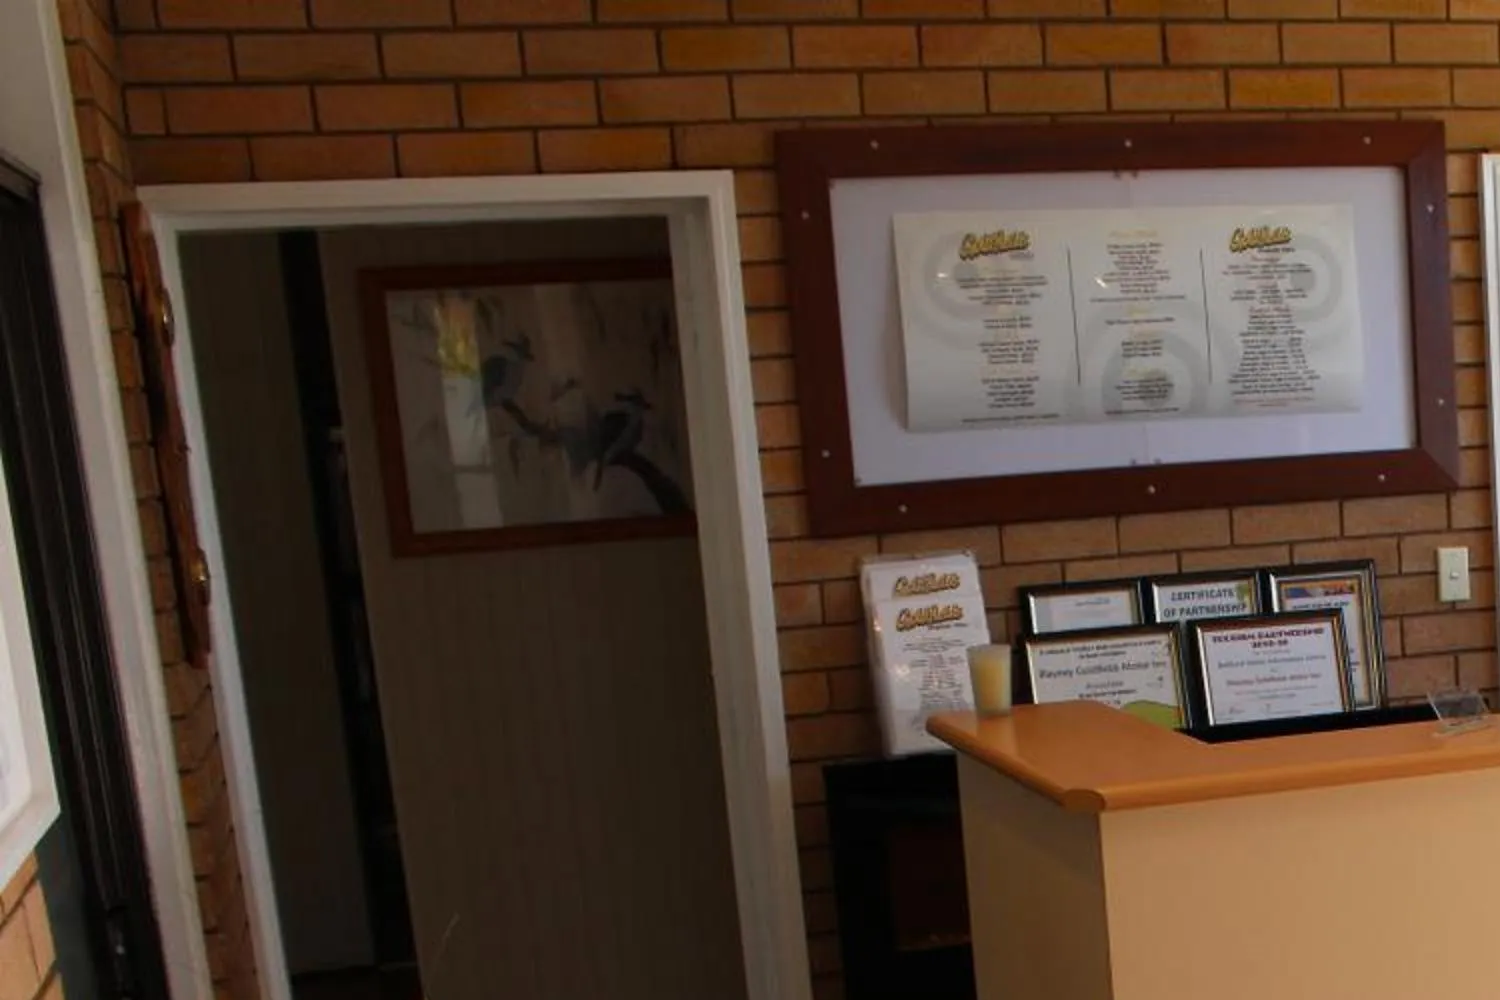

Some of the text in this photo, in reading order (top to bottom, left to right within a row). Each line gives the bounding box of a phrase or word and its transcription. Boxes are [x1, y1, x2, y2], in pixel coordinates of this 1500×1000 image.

[1170, 588, 1235, 601] CERTIFICATE
[1163, 602, 1247, 618] OF PARTNERSHIP
